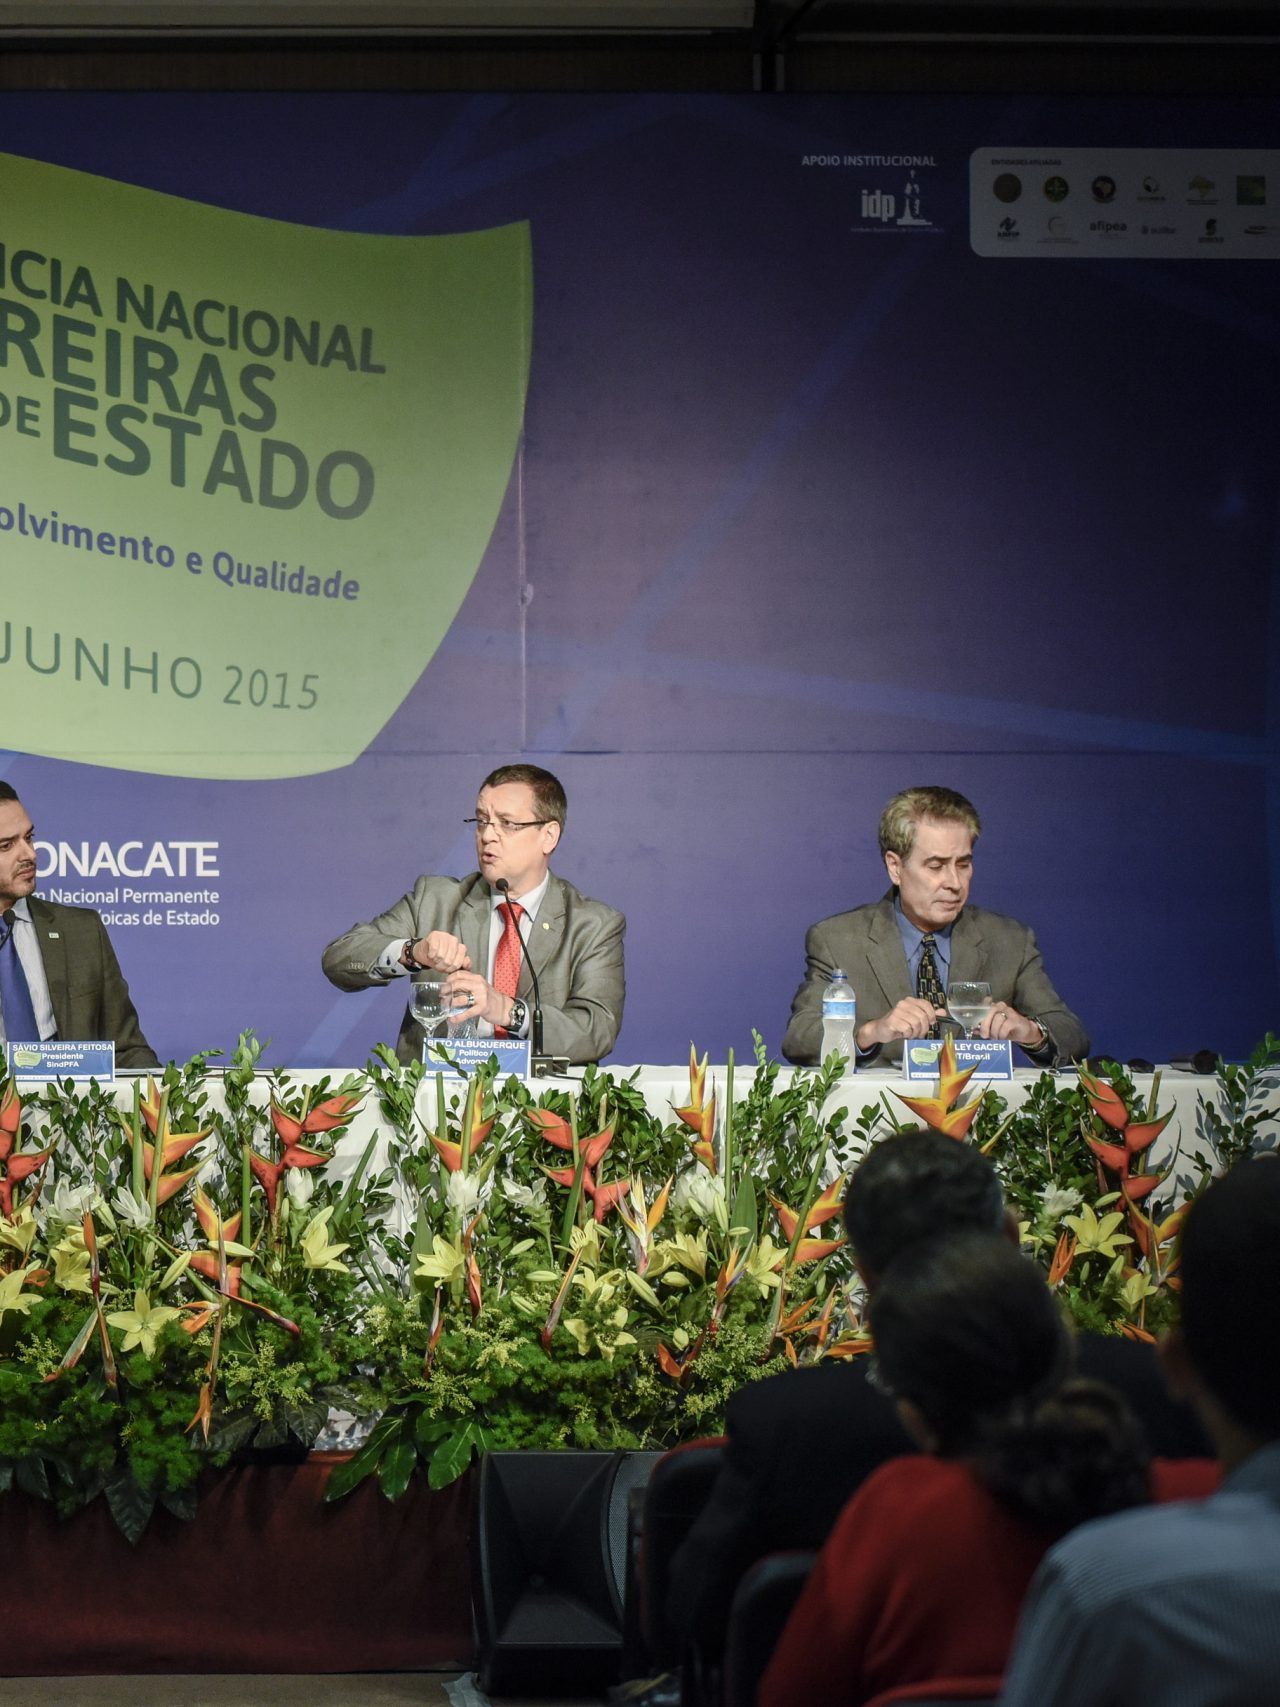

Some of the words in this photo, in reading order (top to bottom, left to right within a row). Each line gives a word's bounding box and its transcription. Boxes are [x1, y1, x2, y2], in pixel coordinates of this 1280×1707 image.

[801, 155, 841, 167] APOIO
[844, 155, 937, 168] INSTITUCIONAL
[861, 189, 896, 223] idp
[1089, 220, 1128, 233] afipea
[116, 276, 386, 375] NACIONAL
[53, 387, 376, 521] ESTADO
[186, 550, 203, 576] e
[212, 550, 361, 602] Qualidade
[222, 664, 320, 711] 2015
[32, 840, 221, 878] ONACATE
[49, 887, 119, 904] Nacional
[122, 887, 221, 904] Permanente
[142, 908, 163, 926] de
[166, 909, 221, 926] Estado
[12, 1042, 39, 1051] SÁVIO
[40, 1043, 77, 1051] SILVEIRA
[77, 1043, 113, 1051] FEITOSA
[454, 1041, 527, 1050] ALBUQUERQUE
[930, 1043, 971, 1051] STLEY
[973, 1043, 1007, 1051] GACEK
